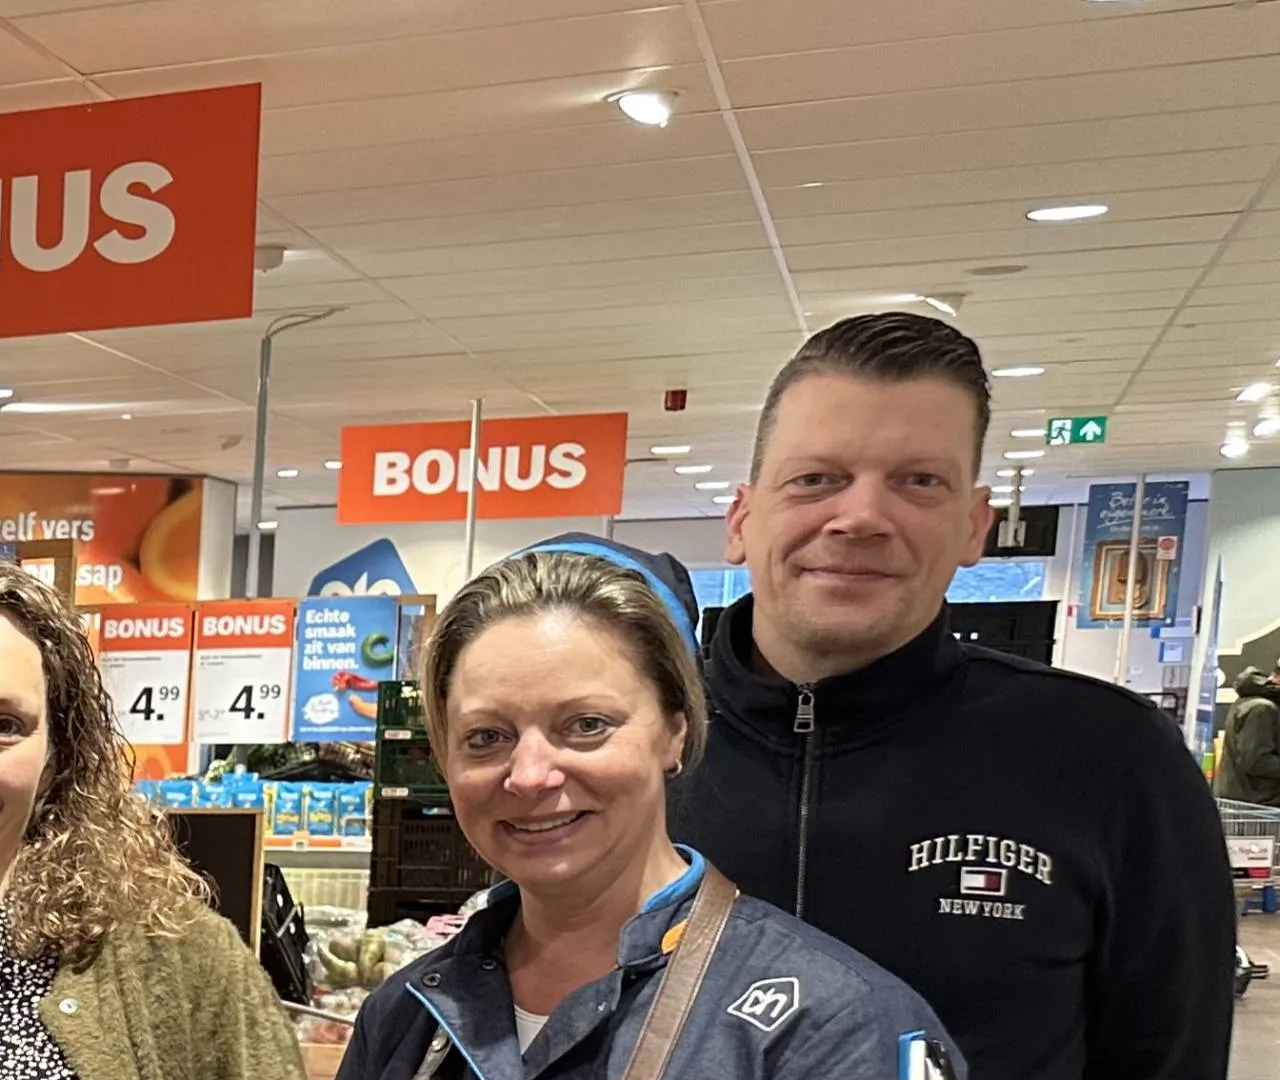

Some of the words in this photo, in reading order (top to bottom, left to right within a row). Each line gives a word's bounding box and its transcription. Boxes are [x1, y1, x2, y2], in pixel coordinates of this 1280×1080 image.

[372, 442, 588, 497] BONUS
[42, 518, 96, 541] vers
[201, 614, 287, 637] BONUS
[305, 607, 351, 625] Echte
[103, 616, 185, 639] BONUS
[304, 624, 357, 639] smaak
[303, 640, 324, 655] zit
[327, 642, 357, 655] van
[302, 656, 360, 671] binnen.
[907, 834, 1053, 885] HILFIGER
[938, 898, 981, 915] NEW
[981, 901, 1027, 920] YORK
